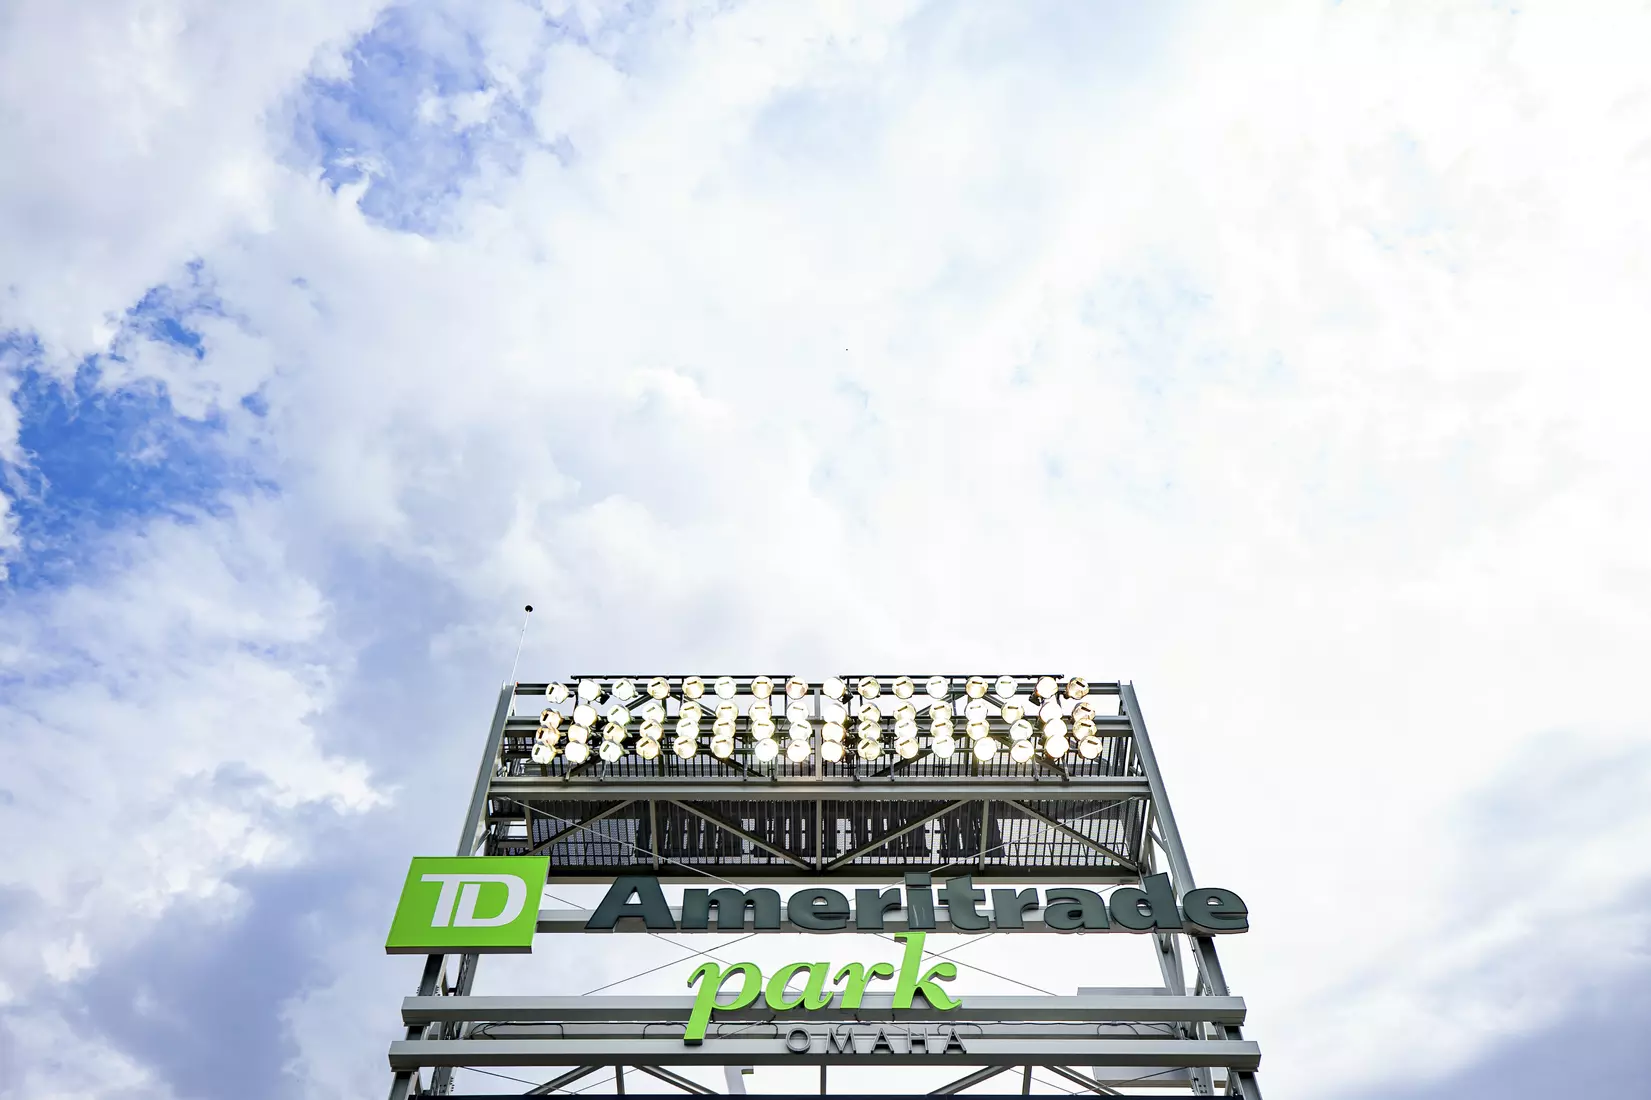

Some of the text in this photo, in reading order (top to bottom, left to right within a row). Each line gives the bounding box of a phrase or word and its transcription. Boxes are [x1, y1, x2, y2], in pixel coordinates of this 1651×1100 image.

[420, 871, 1249, 932] TD Ameritrade
[686, 931, 963, 1046] park
[785, 1027, 968, 1055] OMAHA
